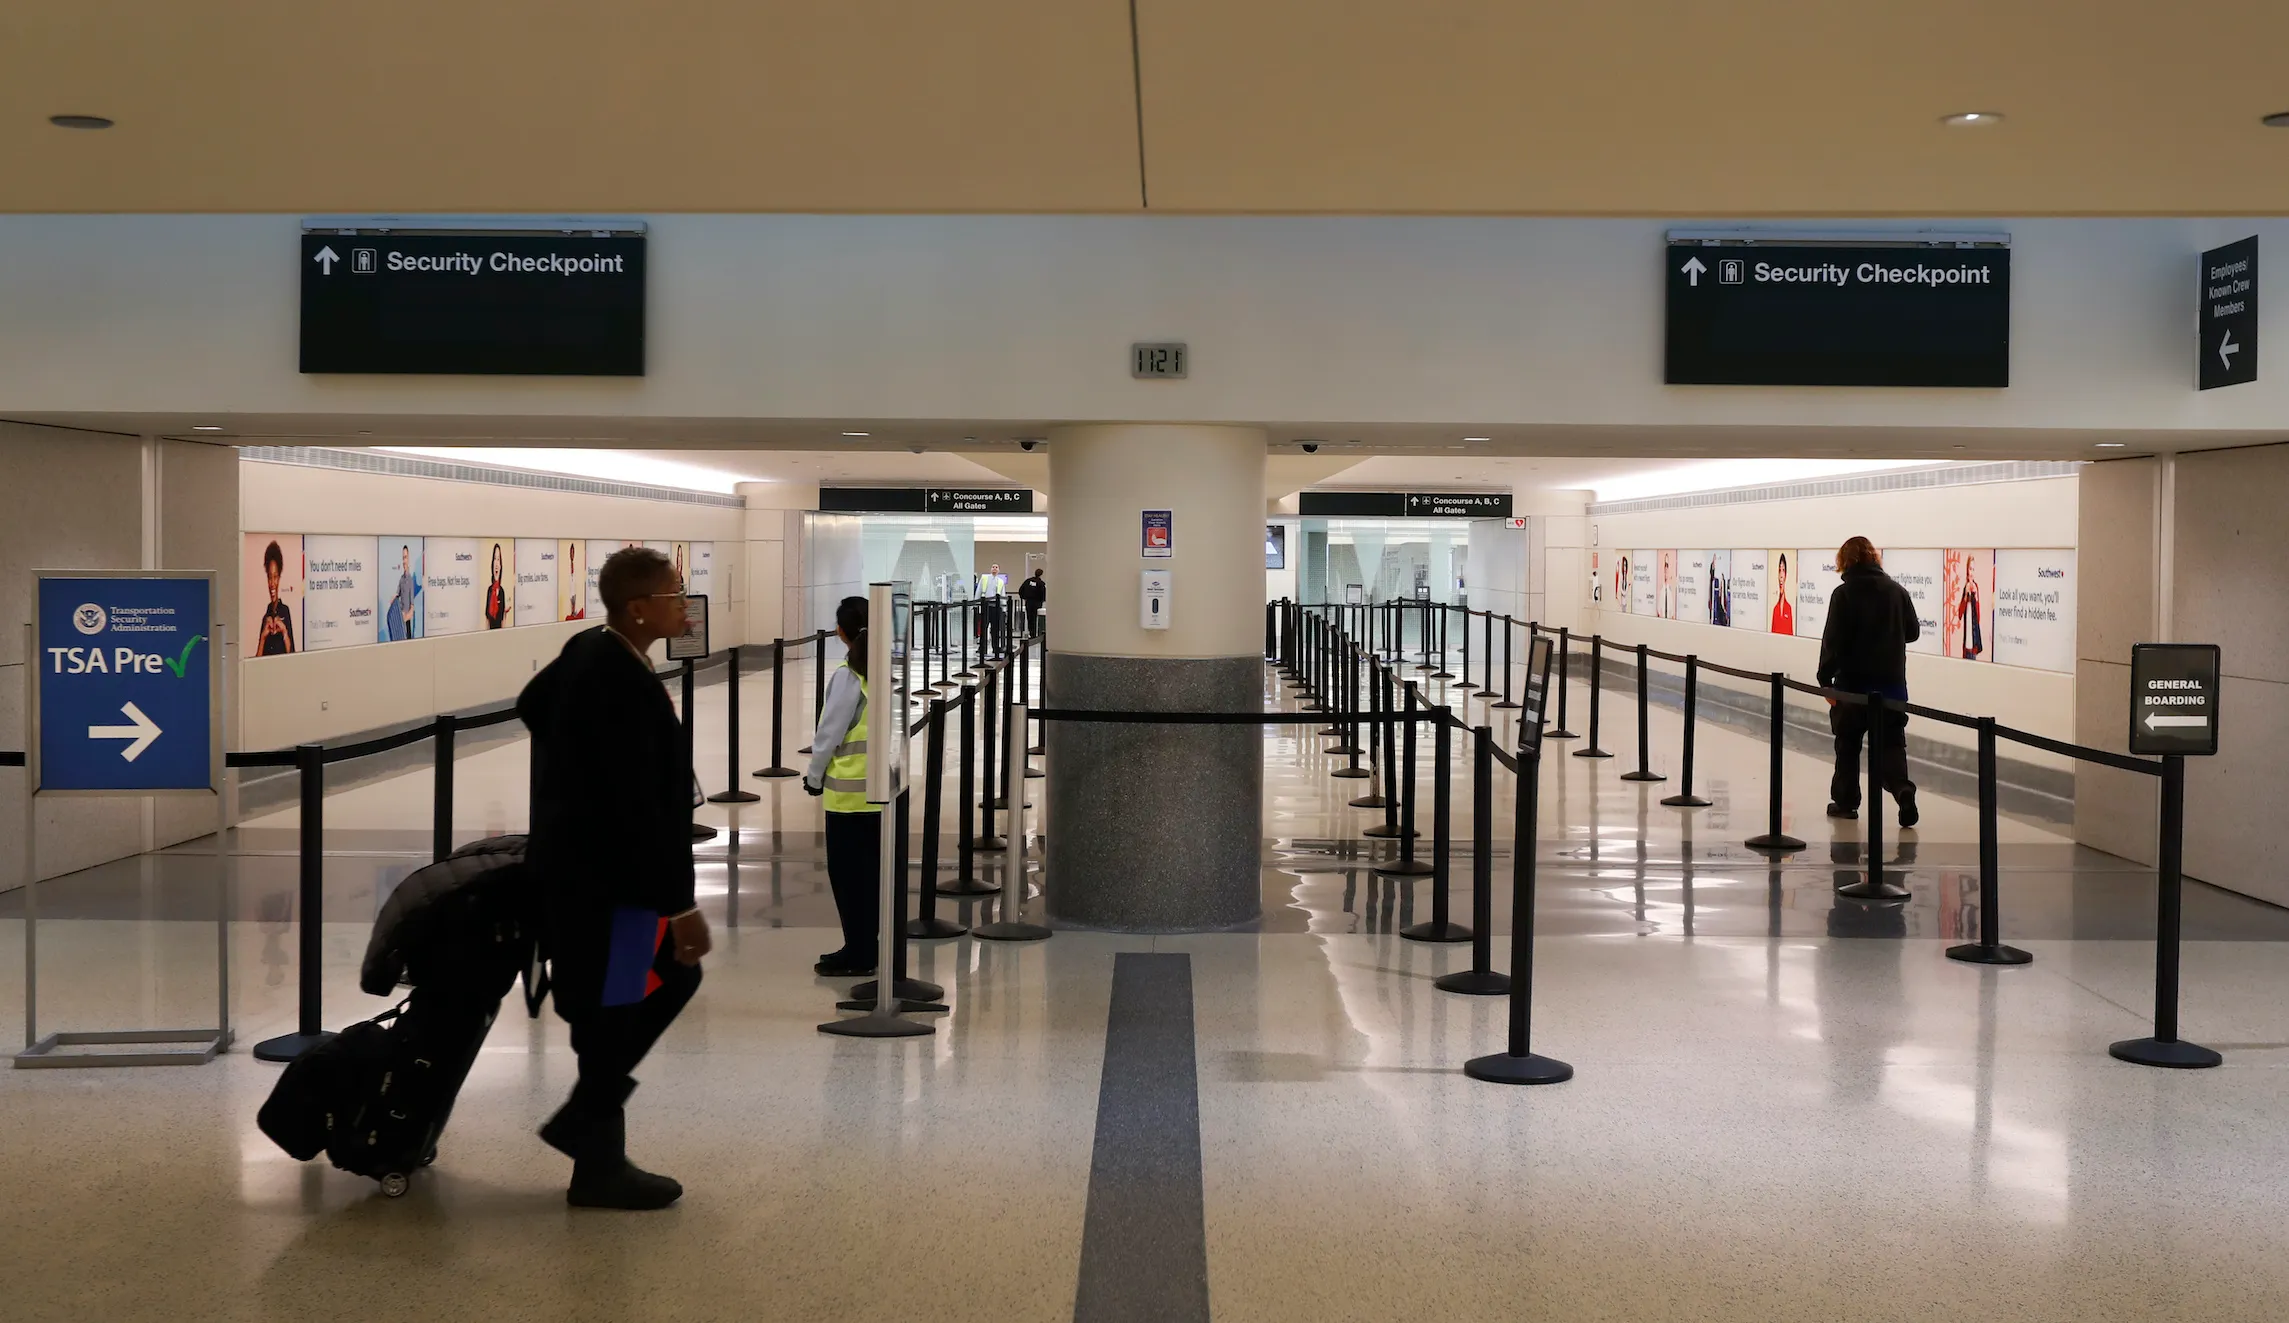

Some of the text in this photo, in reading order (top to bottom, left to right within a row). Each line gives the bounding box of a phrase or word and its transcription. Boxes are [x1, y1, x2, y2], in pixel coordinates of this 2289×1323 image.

[386, 251, 624, 277] Security Checkpoint
[2210, 256, 2249, 281] Employees/
[1754, 262, 1990, 288] Security Checkpoint
[2208, 279, 2251, 300] Known Crew
[2213, 299, 2245, 318] Members
[953, 492, 1020, 502] Concourse A, B, C
[1433, 496, 1500, 506] Concourse A, B, C
[953, 501, 986, 510] All Gates
[1433, 506, 1466, 515] All Gates
[309, 558, 362, 573] You don't need miles
[2038, 567, 2061, 579] Southwest
[309, 576, 354, 591] to earn this smile.
[1913, 575, 1924, 585] make
[1924, 577, 1932, 587] you
[1999, 588, 2011, 601] Look
[2018, 593, 2028, 604] you
[2029, 592, 2043, 603] want,
[2043, 590, 2059, 606] you'll
[110, 606, 175, 616] Transportation
[349, 607, 370, 618] Southwest
[1999, 606, 2057, 621] never find a hidden fee.
[110, 615, 147, 624] Security
[110, 623, 177, 632] Administration
[47, 647, 164, 674] TSA Pre
[2148, 680, 2202, 690] GENERAL
[2145, 696, 2205, 705] BOARDING
